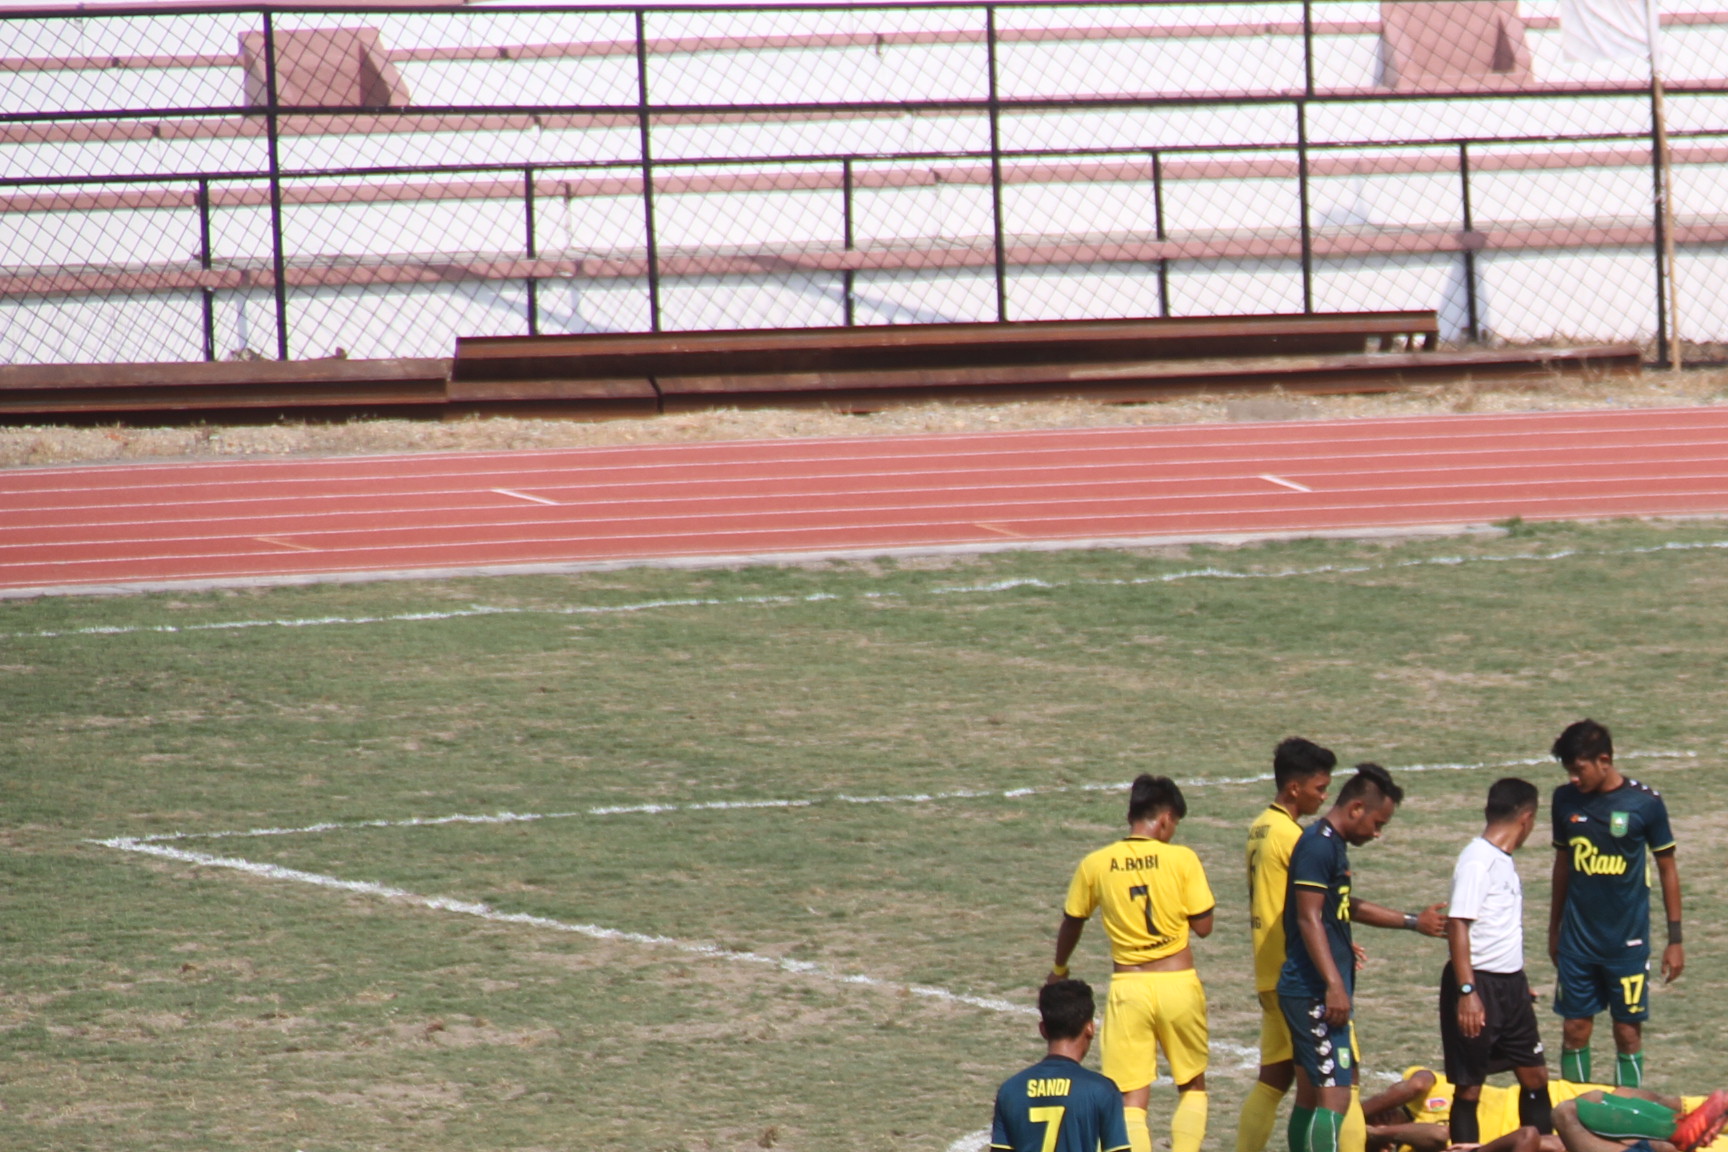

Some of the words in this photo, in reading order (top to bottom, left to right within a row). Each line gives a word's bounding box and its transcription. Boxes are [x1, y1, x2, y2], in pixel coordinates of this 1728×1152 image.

[1569, 837, 1627, 876] Riau
[1129, 884, 1162, 936] 7
[1620, 973, 1645, 1005] 17
[1027, 1078, 1071, 1098] SANDI
